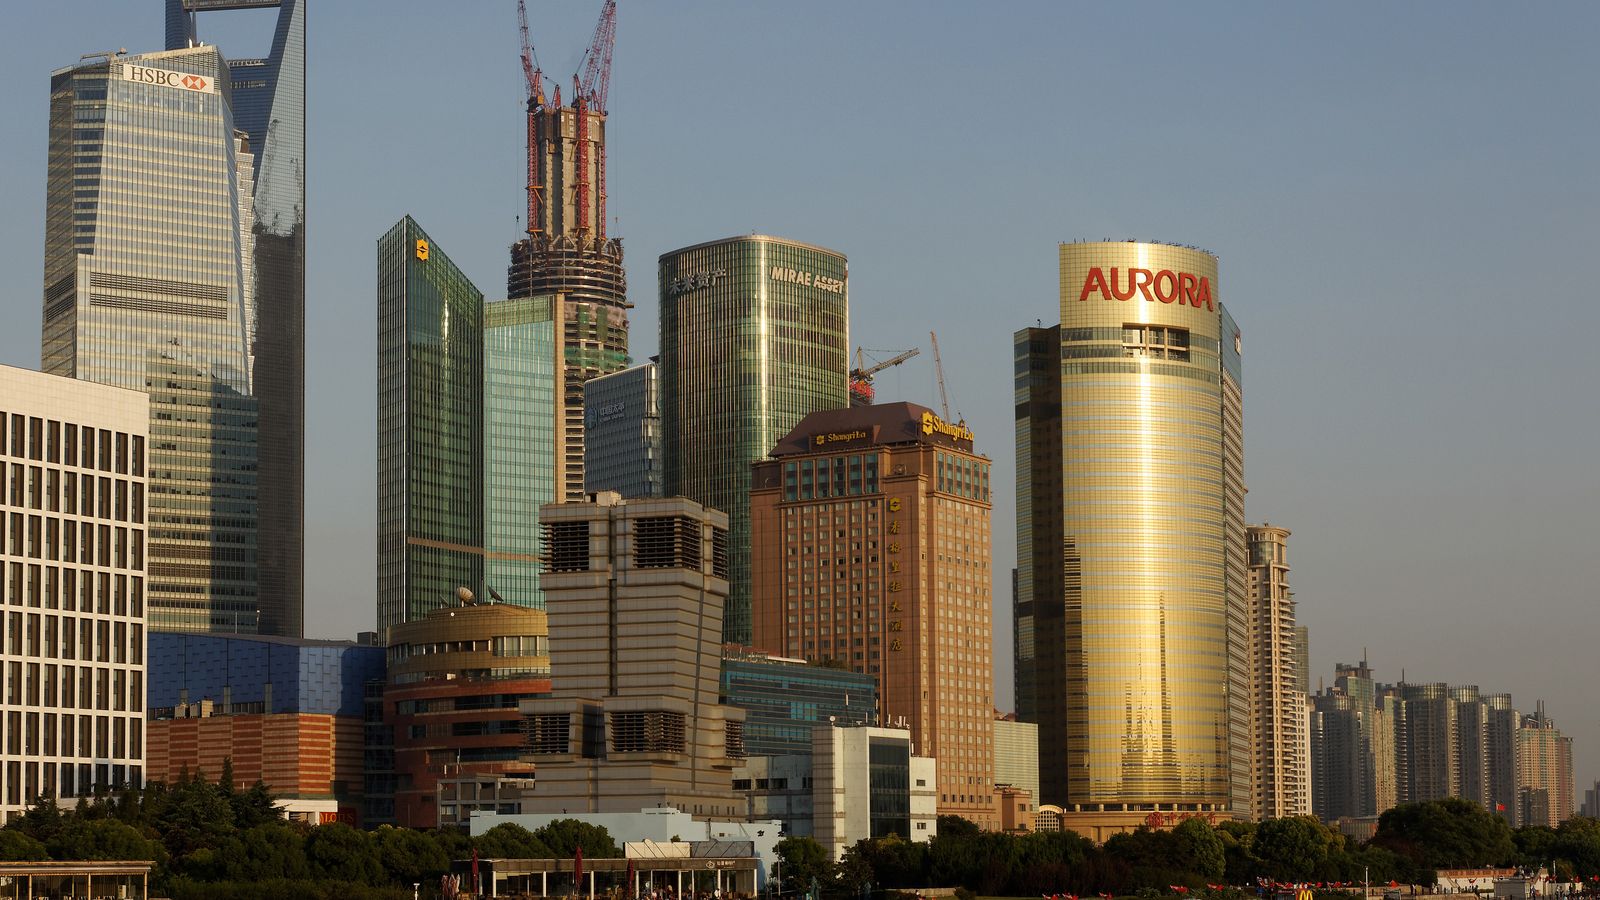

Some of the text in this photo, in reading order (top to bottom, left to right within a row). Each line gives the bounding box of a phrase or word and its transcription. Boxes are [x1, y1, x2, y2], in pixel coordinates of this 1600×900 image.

[131, 66, 179, 87] HSBC
[669, 267, 726, 295] 未来资产
[771, 266, 844, 294] MIRAE ASSET
[1079, 267, 1213, 312] AURORA
